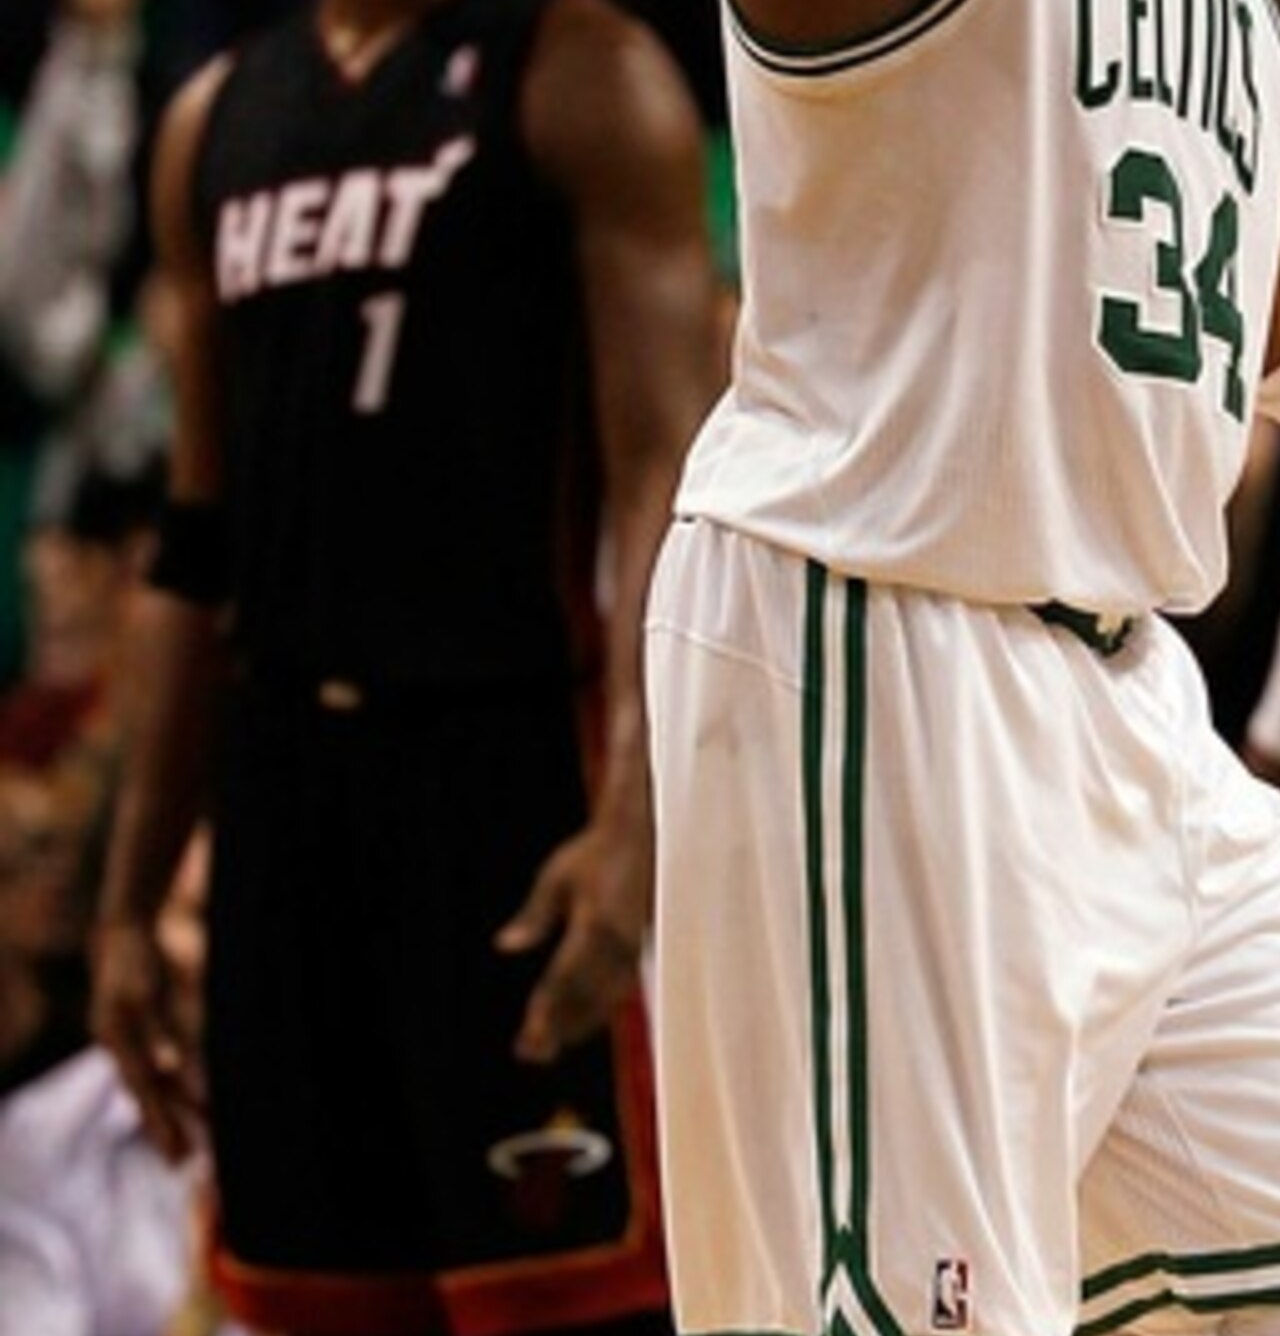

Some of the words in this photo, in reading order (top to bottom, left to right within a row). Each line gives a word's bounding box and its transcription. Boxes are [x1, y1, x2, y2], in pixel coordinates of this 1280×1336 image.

[216, 136, 476, 304] HEAT
[1098, 146, 1245, 424] 34
[354, 291, 406, 415] 1
